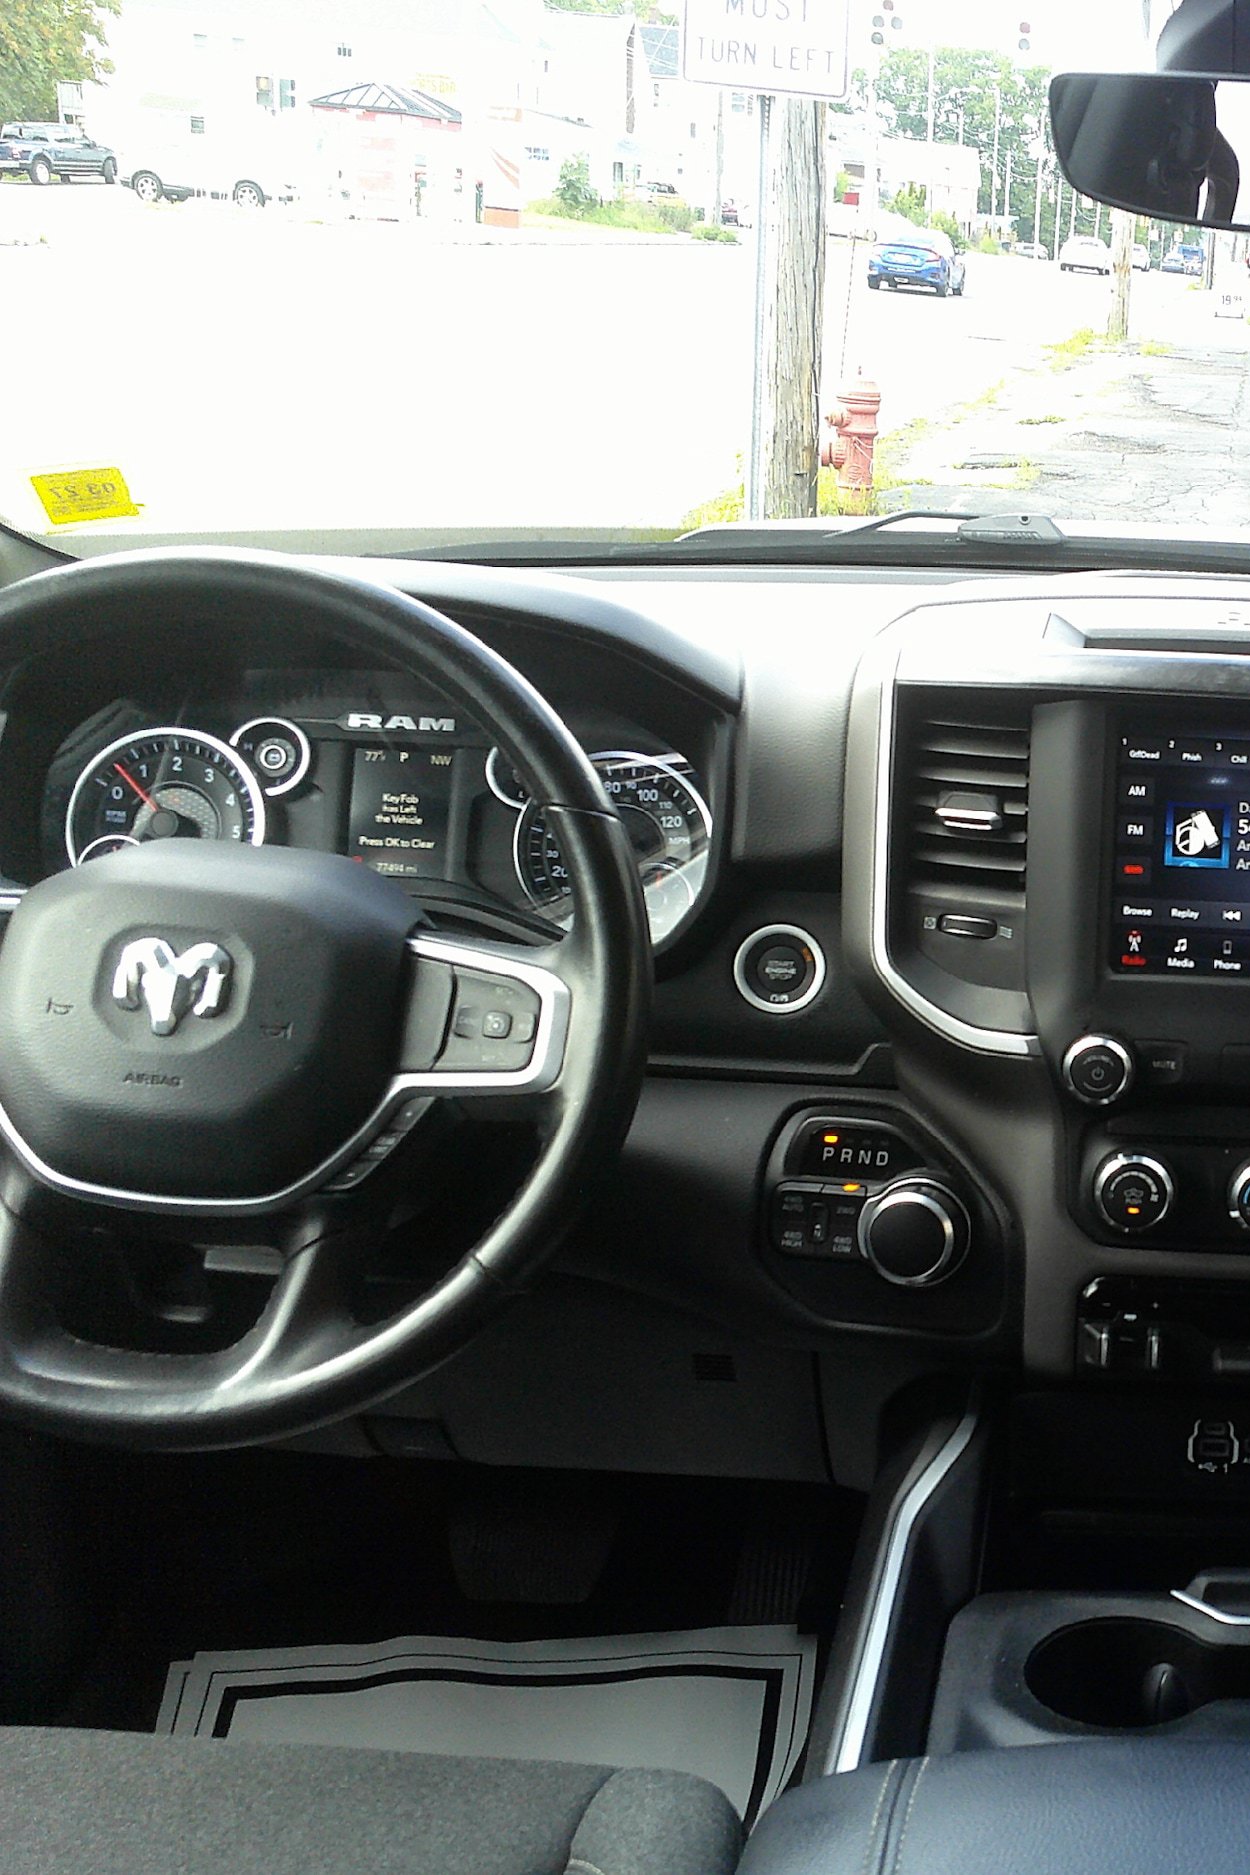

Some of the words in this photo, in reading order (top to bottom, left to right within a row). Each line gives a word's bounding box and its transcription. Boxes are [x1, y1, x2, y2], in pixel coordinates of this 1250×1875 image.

[698, 37, 757, 65] TURN
[773, 46, 834, 73] LEFT
[347, 713, 455, 731] RAM
[1122, 737, 1128, 746] 1
[1169, 739, 1175, 749] 2
[1216, 742, 1222, 751] 3
[400, 752, 409, 762] P
[430, 754, 452, 766] NW
[1181, 752, 1202, 762] Phish
[1230, 755, 1248, 764] Chill
[171, 756, 183, 771] 2
[139, 764, 148, 778] 1
[204, 767, 215, 783] 3
[111, 786, 123, 800] 0
[637, 789, 659, 802] 100
[1128, 785, 1146, 797] AM
[225, 797, 236, 807] 4
[382, 793, 400, 804] Key
[400, 794, 419, 804] Fob
[400, 806, 417, 814] Left
[375, 814, 391, 824] the
[391, 815, 423, 825] Vehicle
[660, 816, 683, 828] 120
[231, 829, 241, 839] 5
[1127, 824, 1145, 836] FM
[358, 836, 384, 847] Press
[384, 838, 400, 847] OK
[401, 840, 410, 848] to
[410, 839, 436, 849] Clear
[668, 836, 691, 846] MPH
[1122, 904, 1153, 917] Browse
[1170, 907, 1200, 921] Replay
[1121, 954, 1148, 967] Radio
[1166, 956, 1196, 969] Media
[1213, 958, 1242, 971] Phone
[1152, 1060, 1176, 1071] MUTE
[122, 1072, 181, 1087] AIRBAG
[822, 1147, 835, 1161] P
[840, 1148, 853, 1163] R
[858, 1150, 872, 1165] N
[876, 1151, 889, 1166] D
[1223, 1463, 1229, 1474] 1
